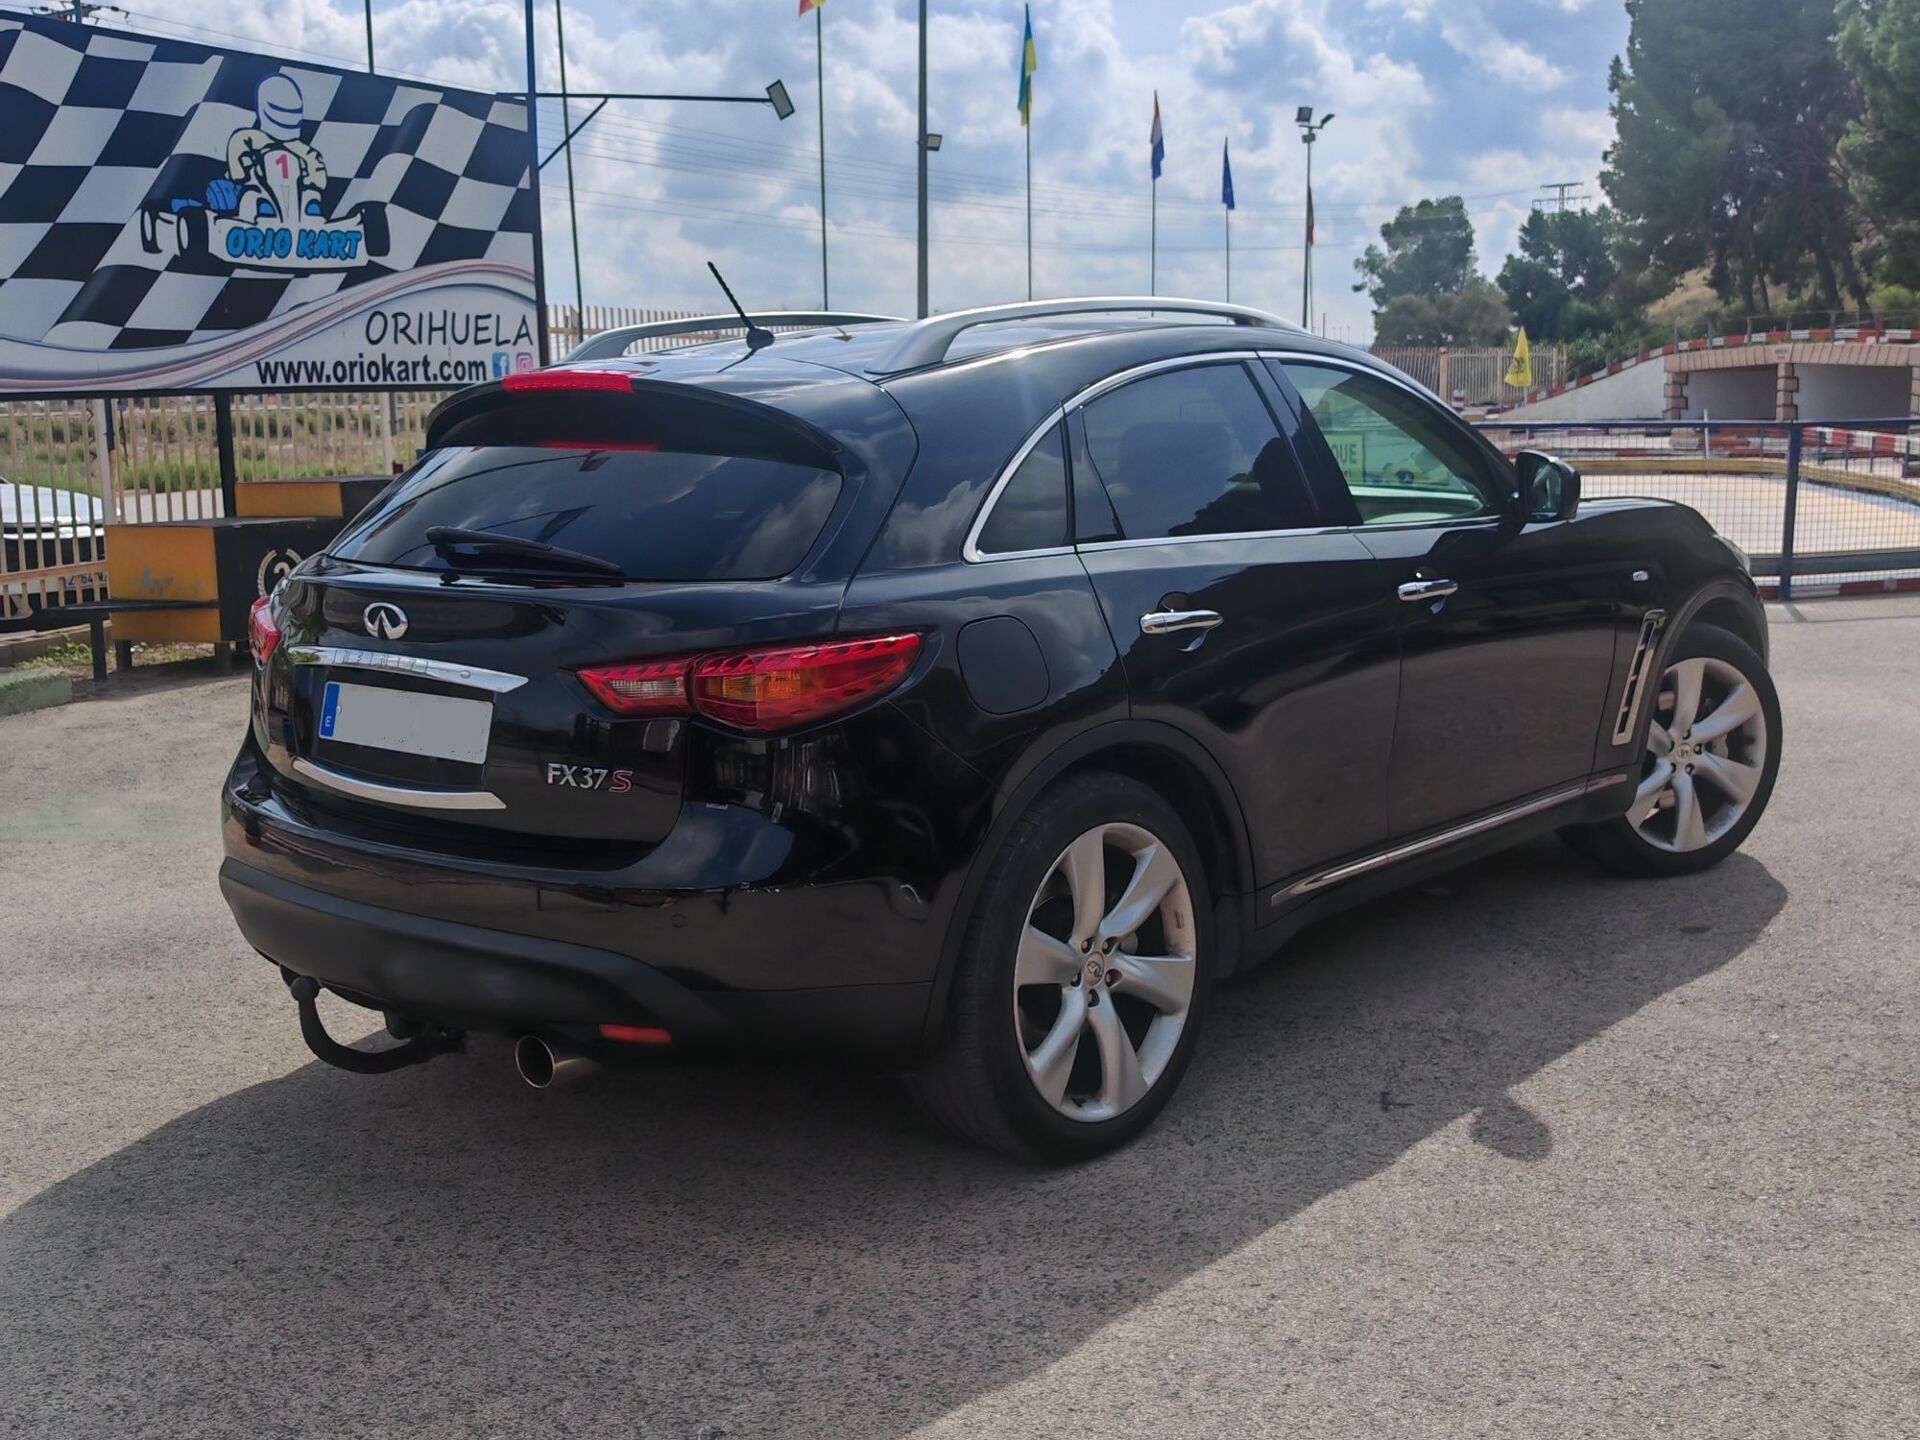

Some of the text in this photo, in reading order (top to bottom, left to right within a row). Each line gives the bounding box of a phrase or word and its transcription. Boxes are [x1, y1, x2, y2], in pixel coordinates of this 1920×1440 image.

[276, 154, 288, 179] 1
[226, 226, 362, 260] ORIO KART
[365, 310, 534, 346] ORIHUELA
[256, 353, 487, 384] www.oriokart.com
